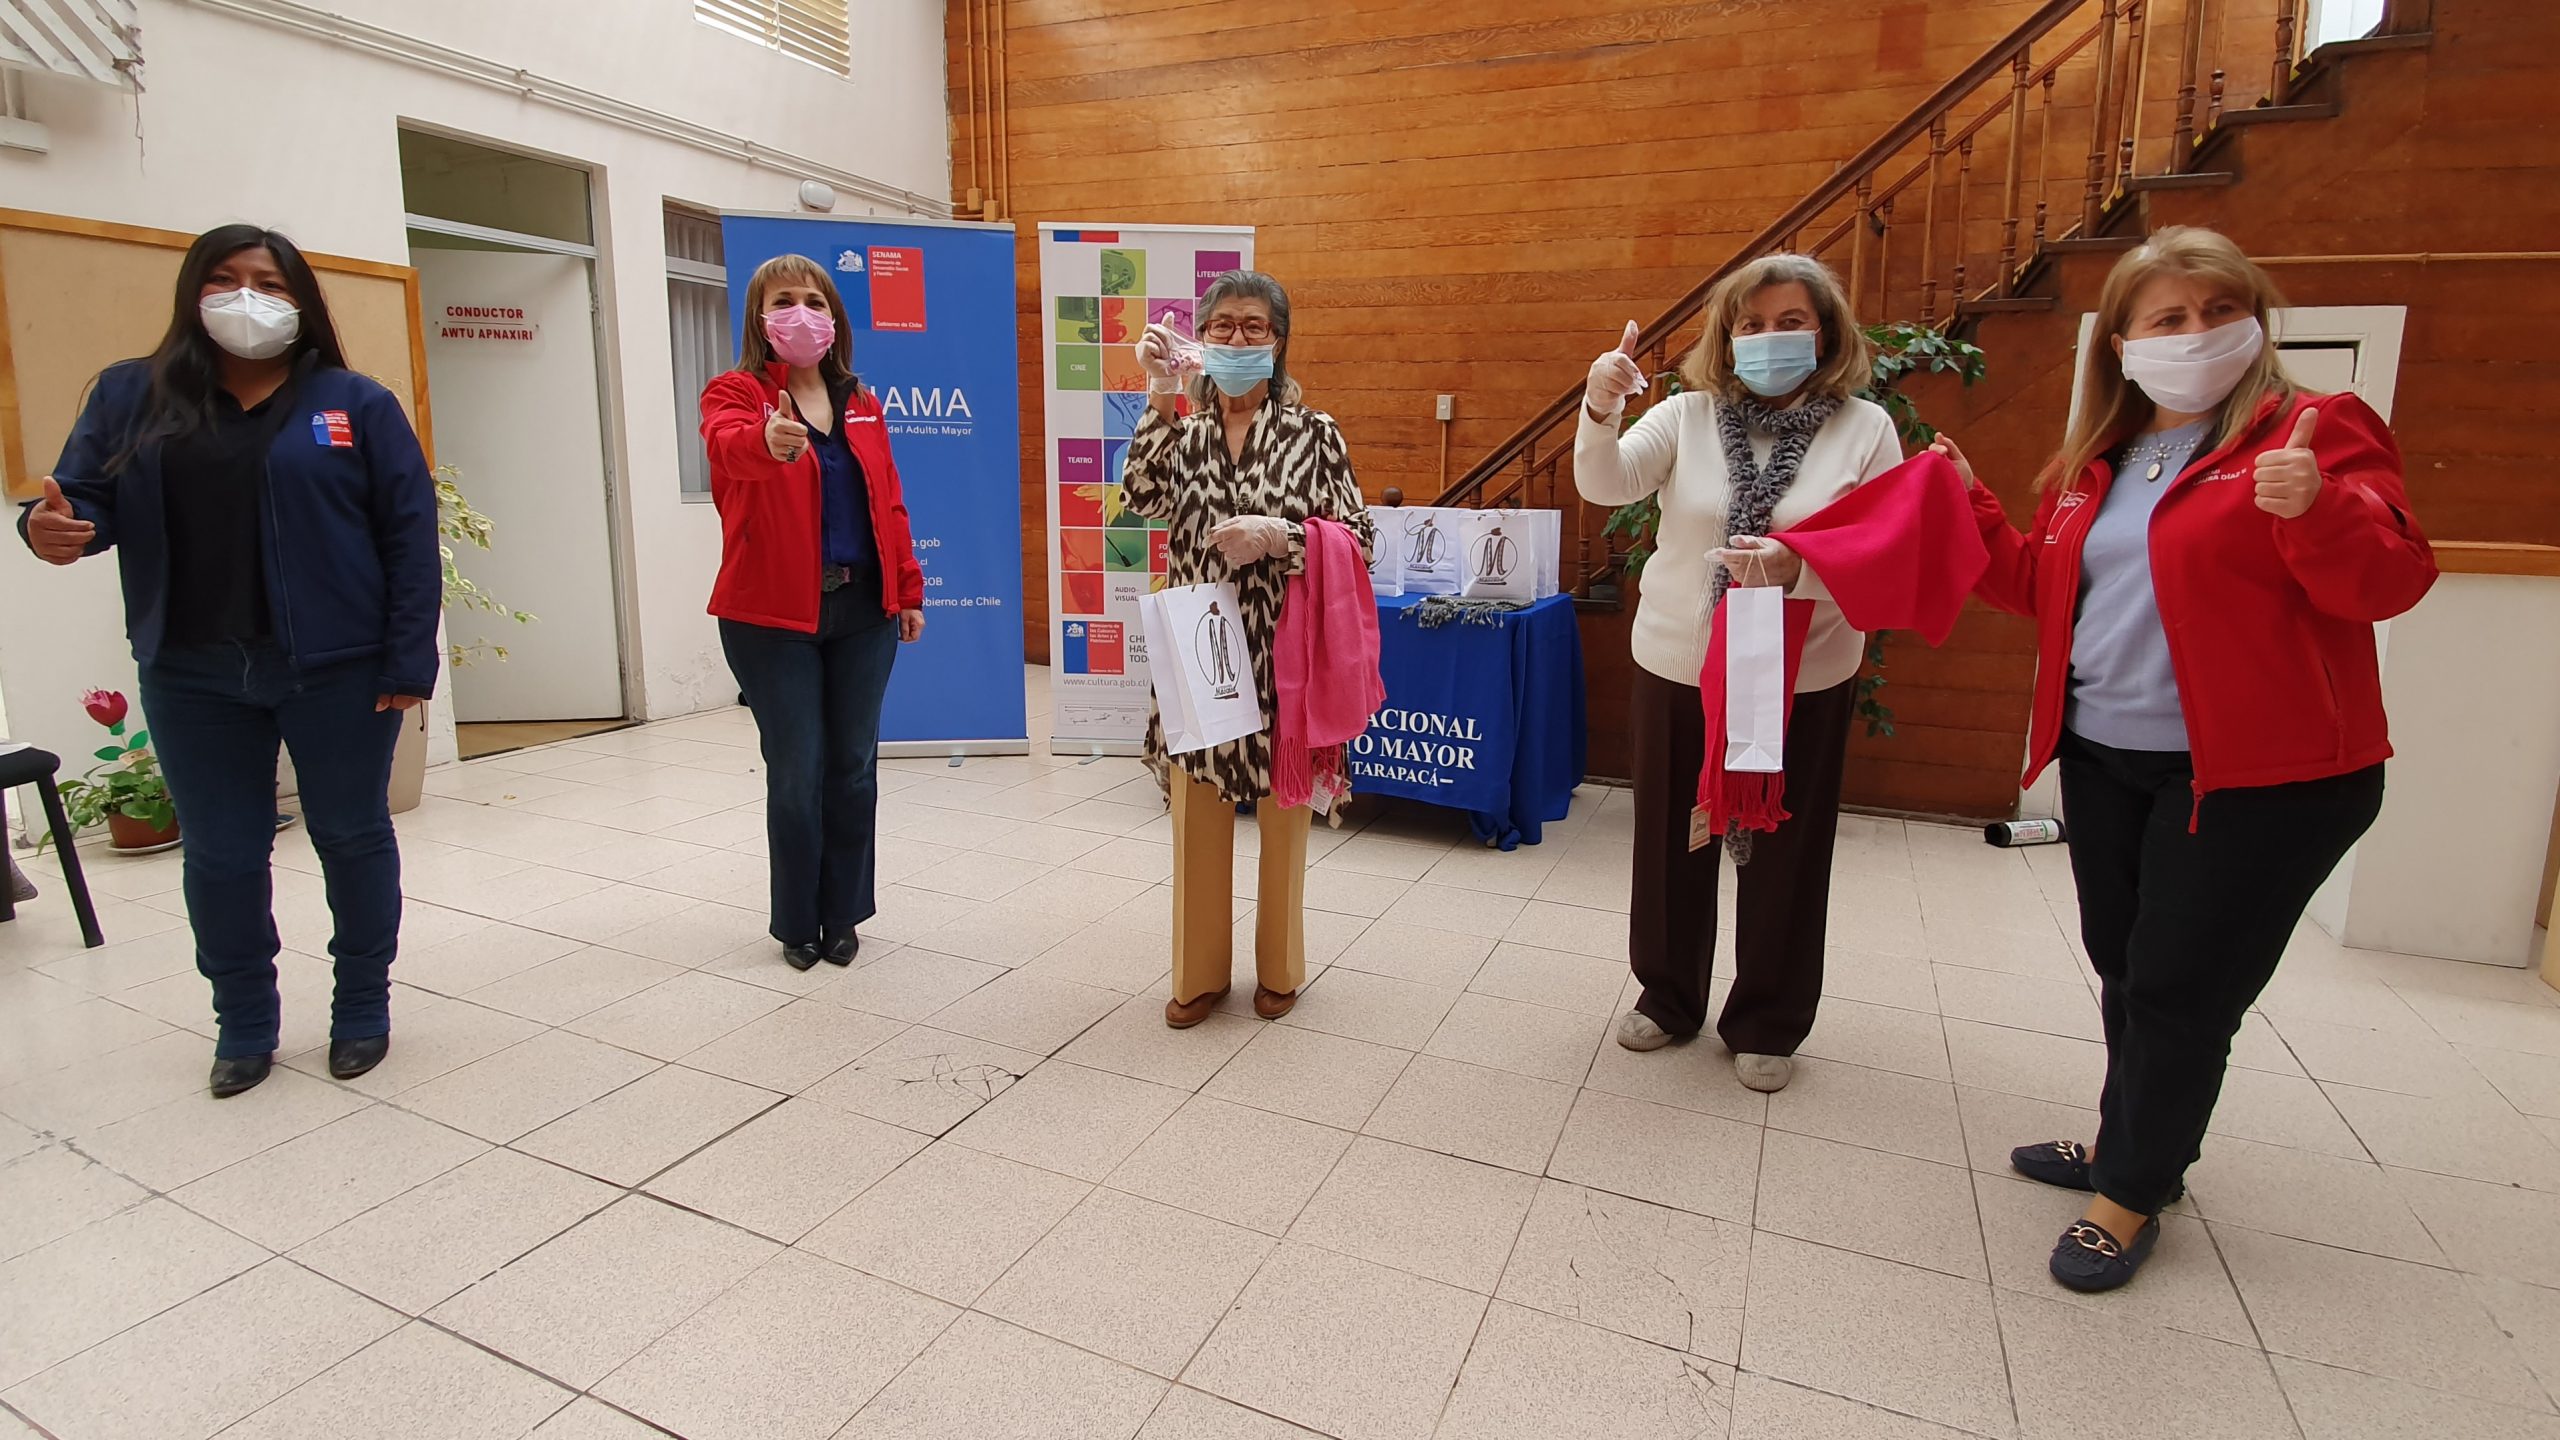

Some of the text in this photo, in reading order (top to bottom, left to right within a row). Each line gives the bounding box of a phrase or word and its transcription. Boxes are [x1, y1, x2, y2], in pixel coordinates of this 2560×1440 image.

[872, 251, 902, 259] SENAMA
[1196, 270, 1224, 278] LITERAT
[446, 306, 524, 319] CONDUCTOR
[441, 327, 533, 341] AWTU APNAXIRI
[1070, 363, 1087, 371] CINE
[870, 385, 972, 418] AMA
[887, 424, 972, 437] del Adulto Mayor
[1067, 456, 1093, 464] TEATRO
[960, 597, 973, 607] de
[976, 596, 1001, 607] Chile
[1129, 654, 1149, 663] TOD
[1347, 734, 1475, 770] O MAYOR
